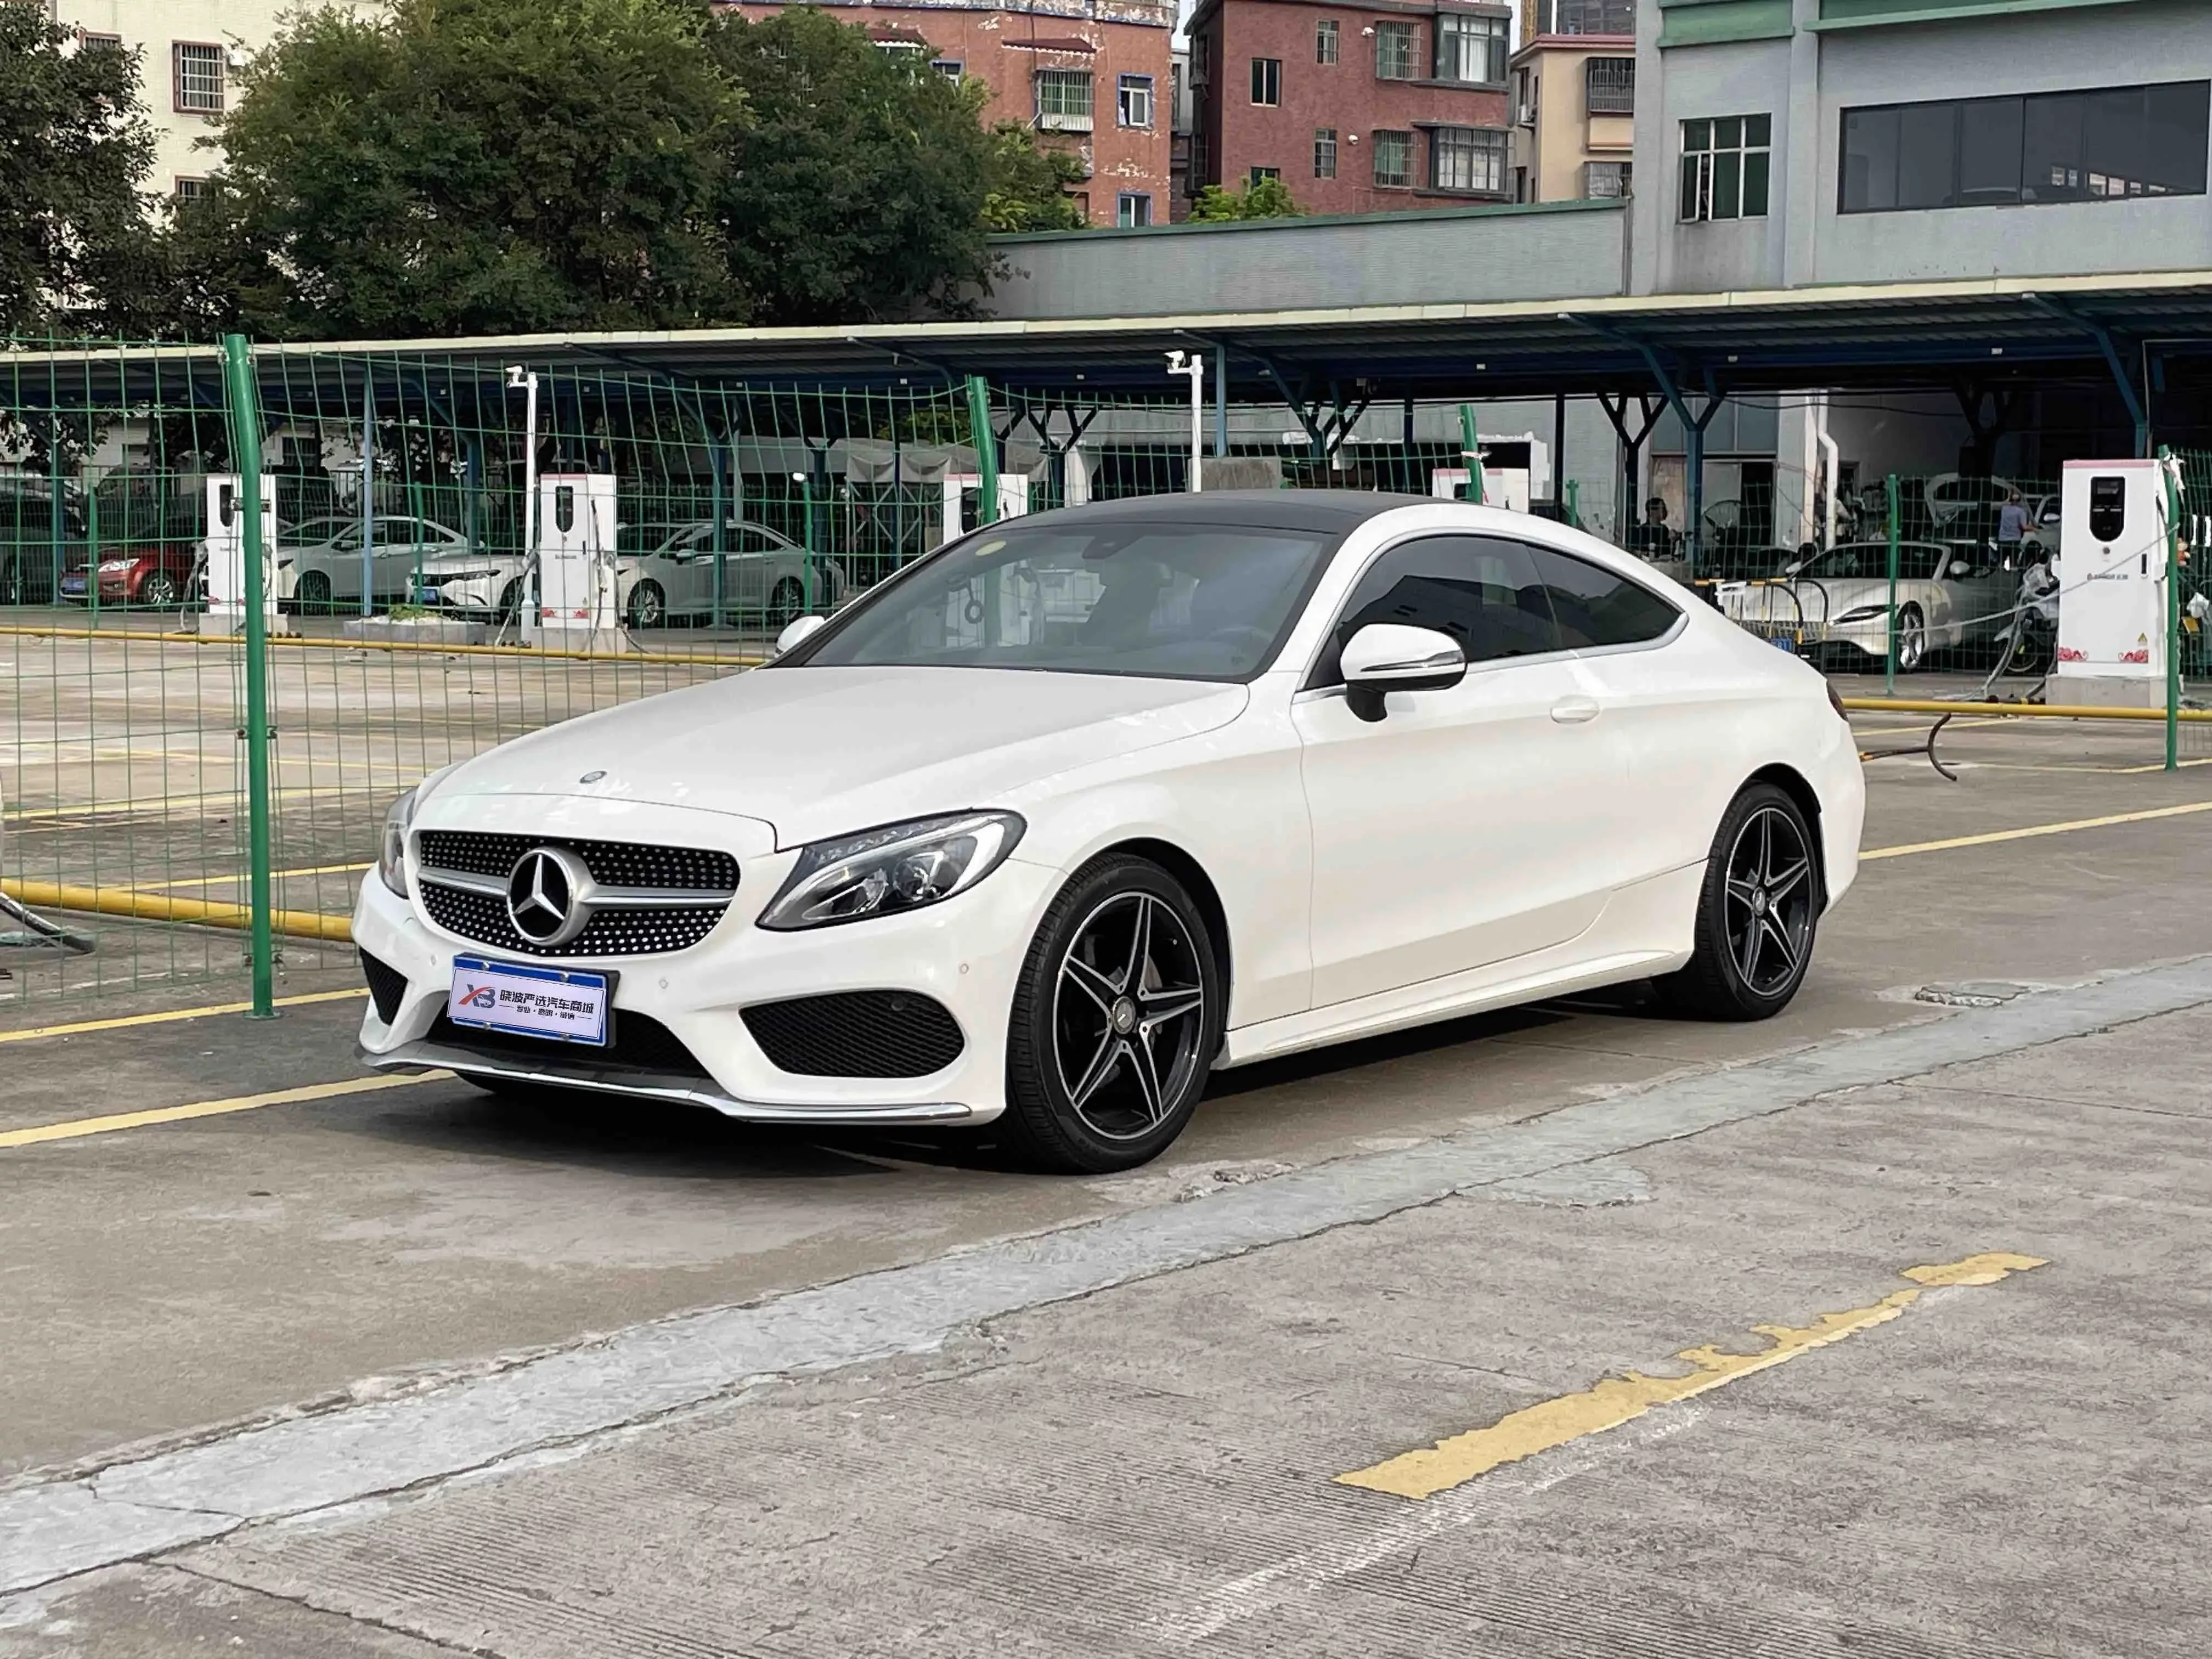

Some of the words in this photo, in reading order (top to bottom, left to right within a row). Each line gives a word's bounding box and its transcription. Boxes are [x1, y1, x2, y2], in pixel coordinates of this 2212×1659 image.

[500, 989, 595, 1014] 晓波严选汽车商城
